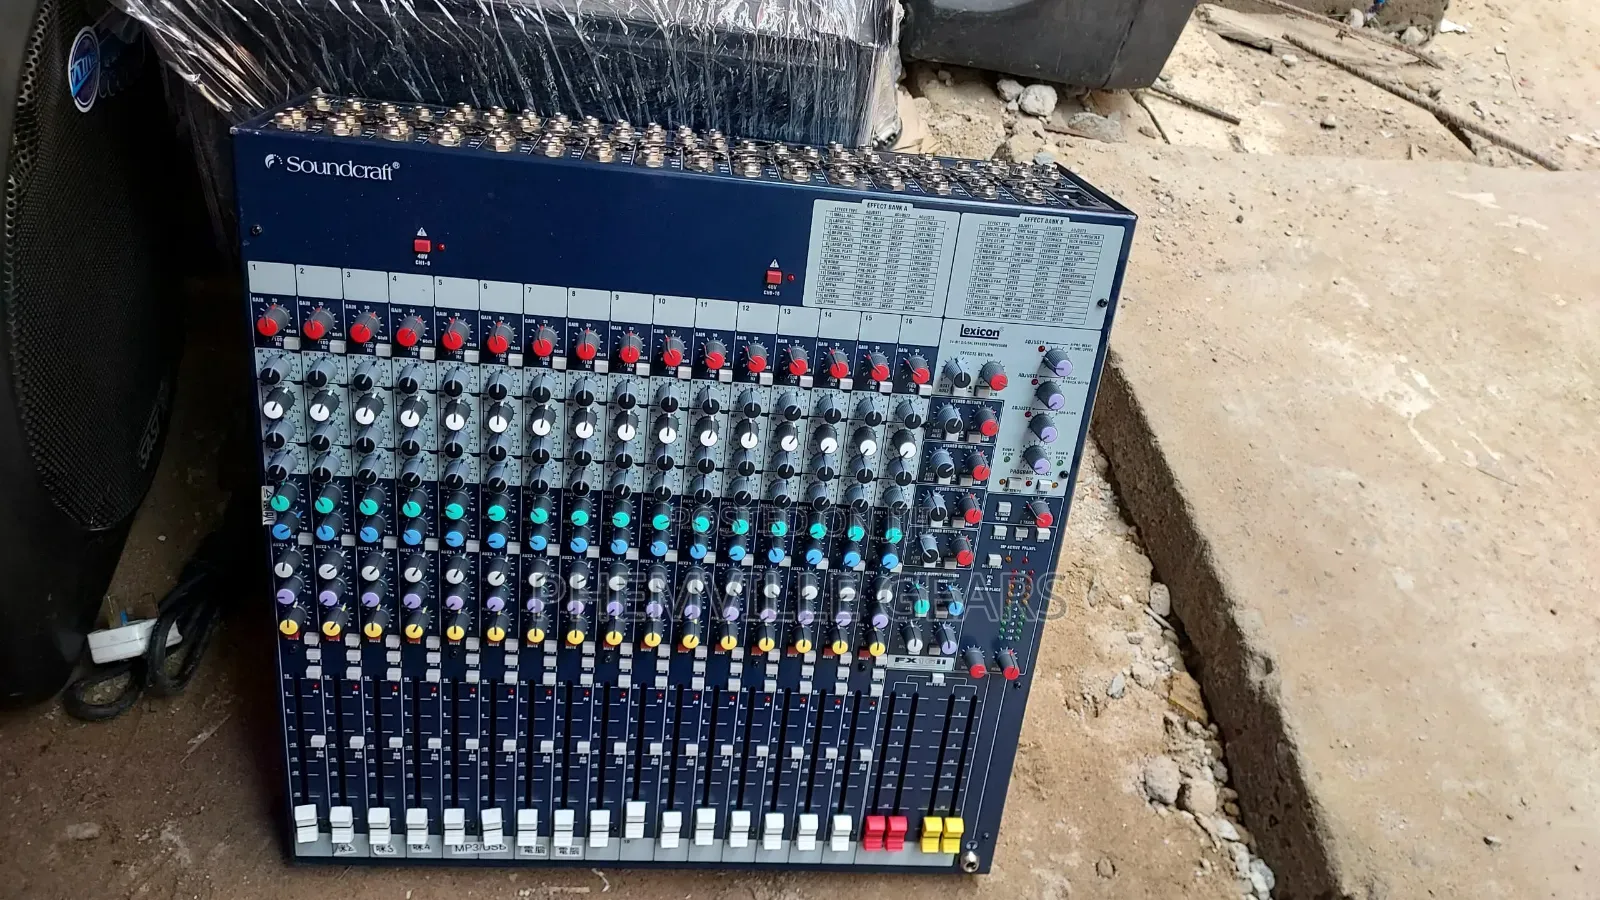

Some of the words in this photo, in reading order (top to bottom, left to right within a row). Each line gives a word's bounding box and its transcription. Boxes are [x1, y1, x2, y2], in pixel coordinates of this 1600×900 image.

[867, 202, 886, 210] EFFECT
[1024, 216, 1044, 224] EFFECT
[527, 286, 532, 294] 7
[865, 314, 873, 322] 15
[905, 317, 913, 325] 16
